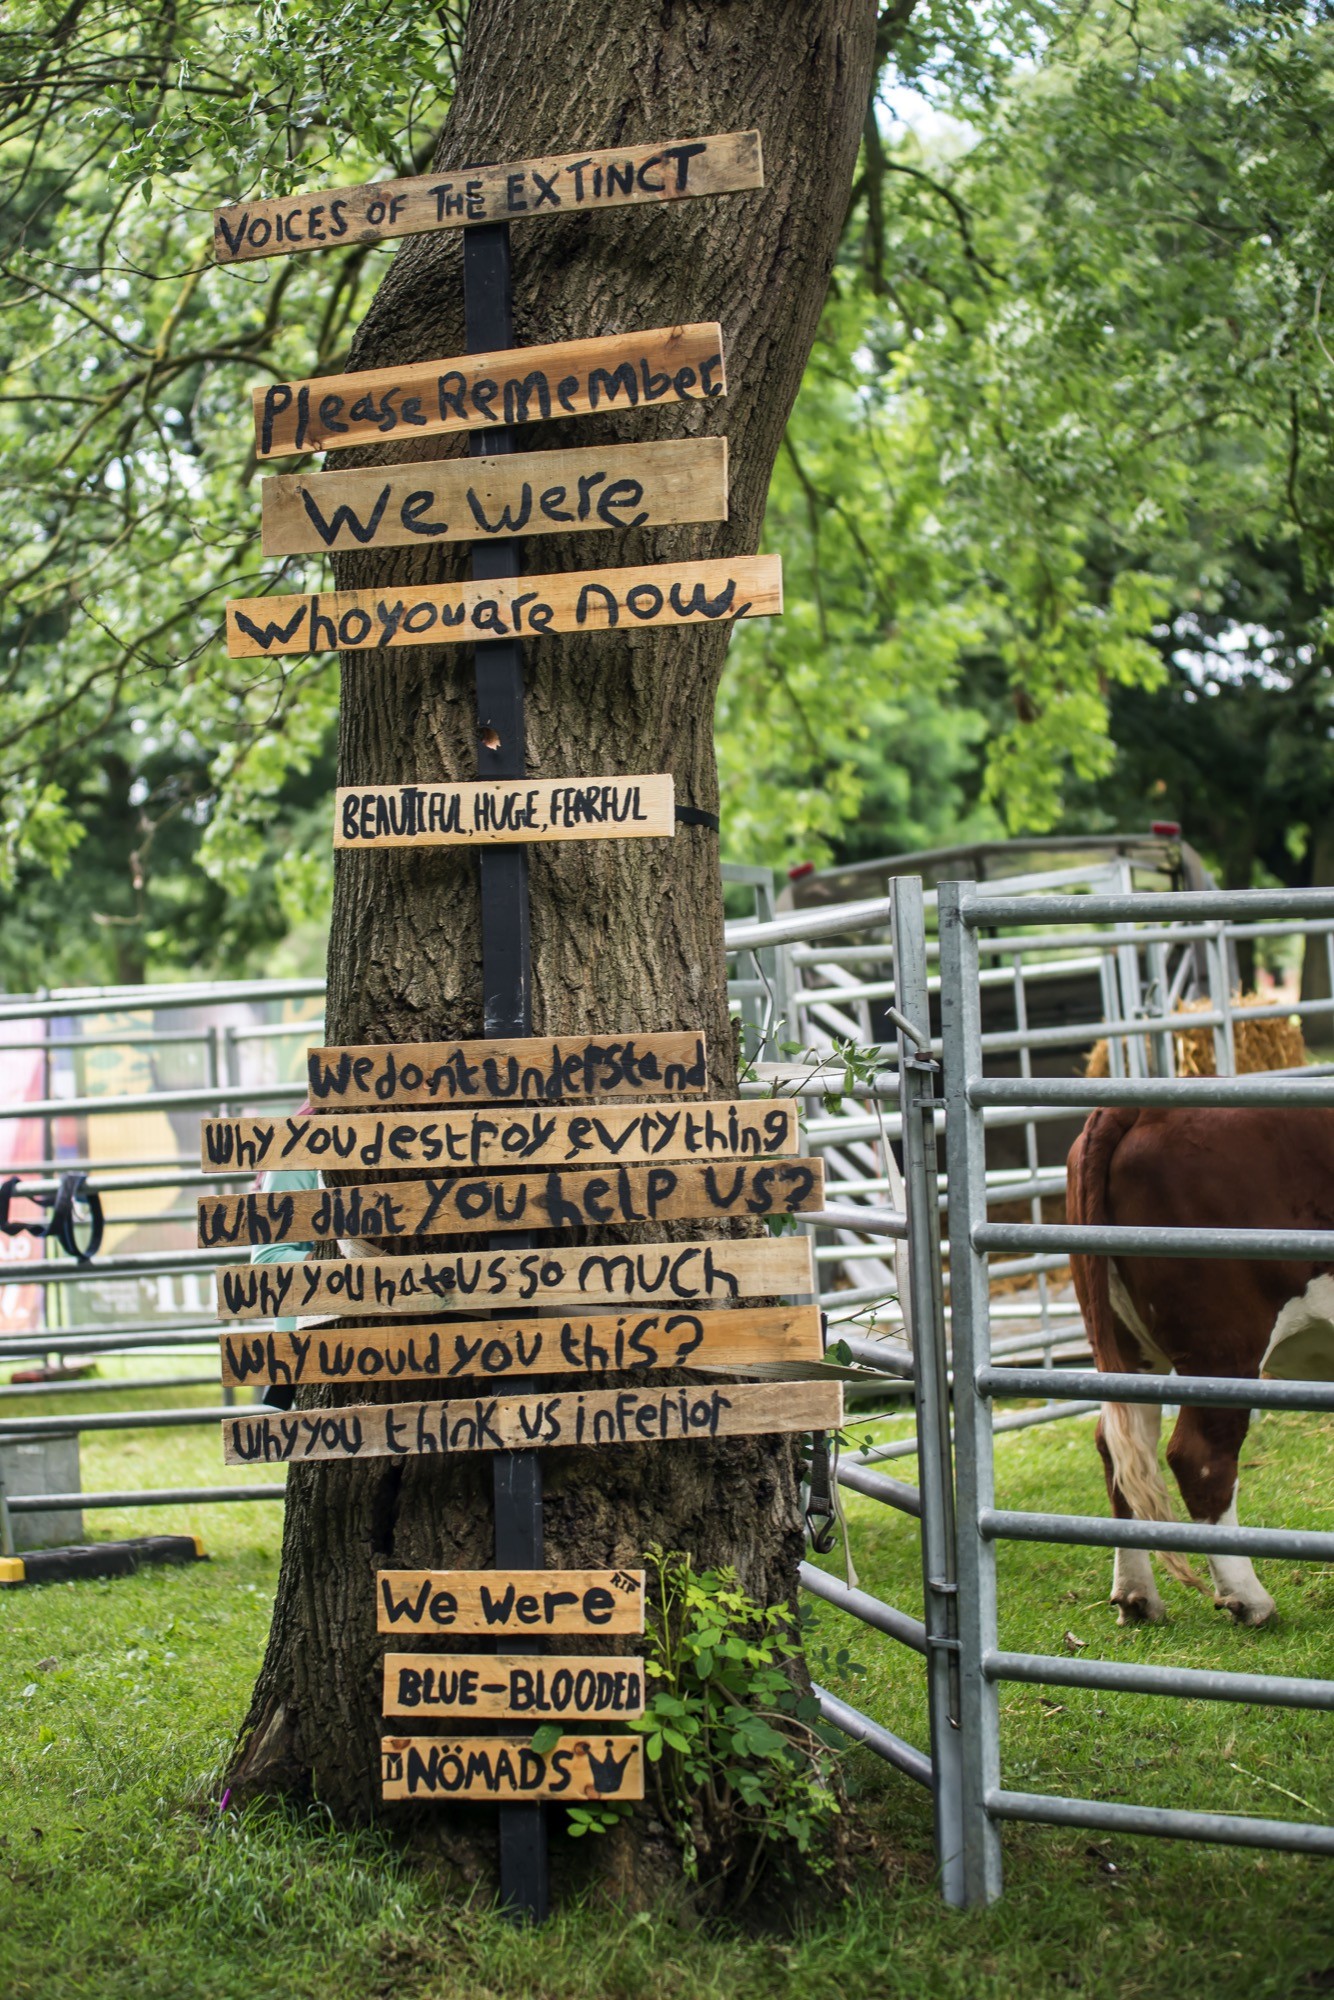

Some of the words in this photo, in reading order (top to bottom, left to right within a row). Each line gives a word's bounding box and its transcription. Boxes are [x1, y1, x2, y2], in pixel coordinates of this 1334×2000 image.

[219, 200, 348, 256] VOICES
[366, 194, 408, 225] OF
[428, 181, 487, 222] THE
[507, 143, 707, 212] EXTINCT
[262, 385, 427, 454] Please
[301, 483, 448, 546] We
[474, 790, 548, 833] HUGE,
[550, 786, 648, 827] FEARFUL
[206, 1123, 275, 1169] Why
[199, 1193, 294, 1245] Why
[311, 1187, 406, 1238] didn't
[224, 1265, 294, 1317] Why
[225, 1332, 312, 1385] Why
[319, 1332, 440, 1376] would
[232, 1417, 299, 1462] Why
[381, 1578, 458, 1625] We
[609, 1571, 637, 1595] RIP
[398, 1668, 642, 1712] BLUE-BLOODED
[407, 1744, 575, 1794] NÖMADS
